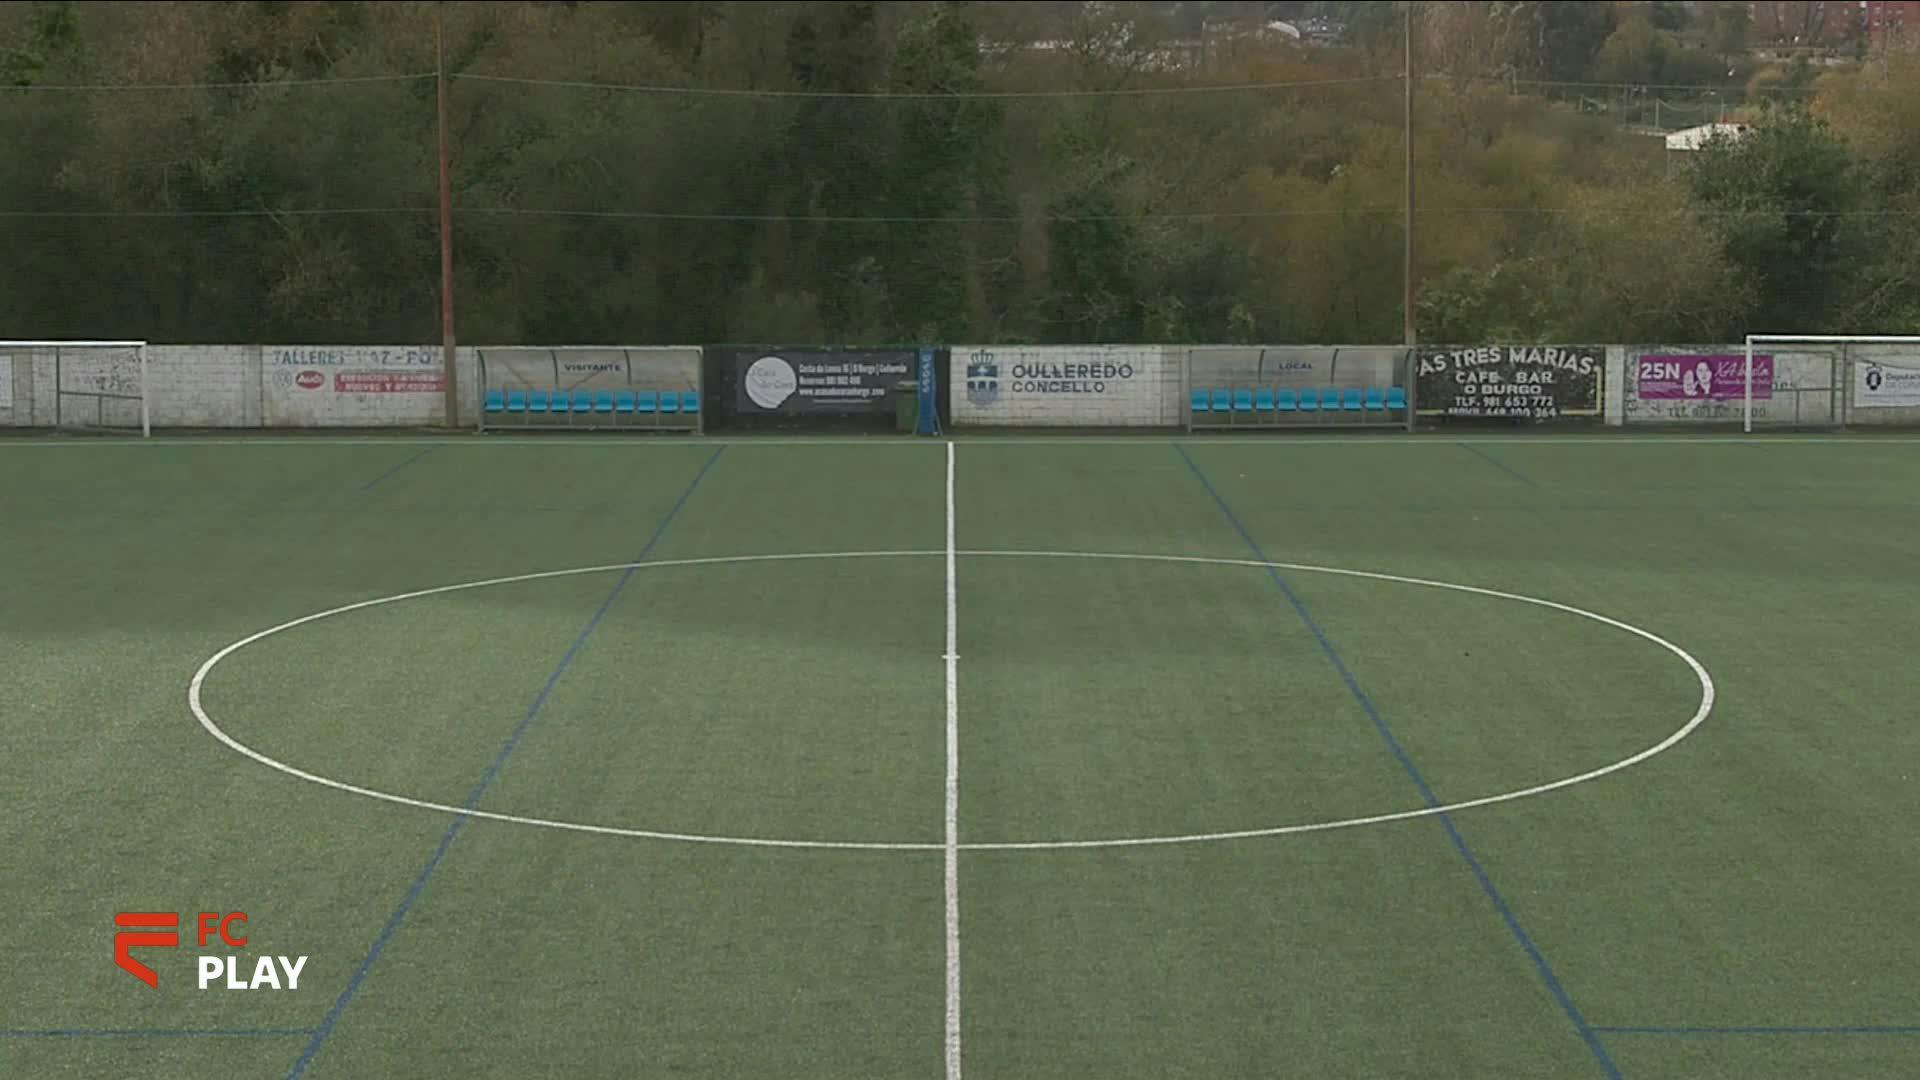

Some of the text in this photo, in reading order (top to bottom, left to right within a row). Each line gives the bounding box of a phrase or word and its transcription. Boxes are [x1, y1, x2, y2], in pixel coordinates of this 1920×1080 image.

[564, 363, 621, 372] VISITANTE
[1279, 362, 1313, 370] LOCAL
[1416, 348, 1595, 377] AS TRES MARIAS
[1640, 363, 1681, 379] 25N
[1455, 371, 1553, 384] CAFE BAR
[1012, 381, 1105, 393] CONCELLO
[1464, 384, 1543, 396] O BURGO
[1483, 396, 1501, 408] 981
[1504, 396, 1527, 408] 653
